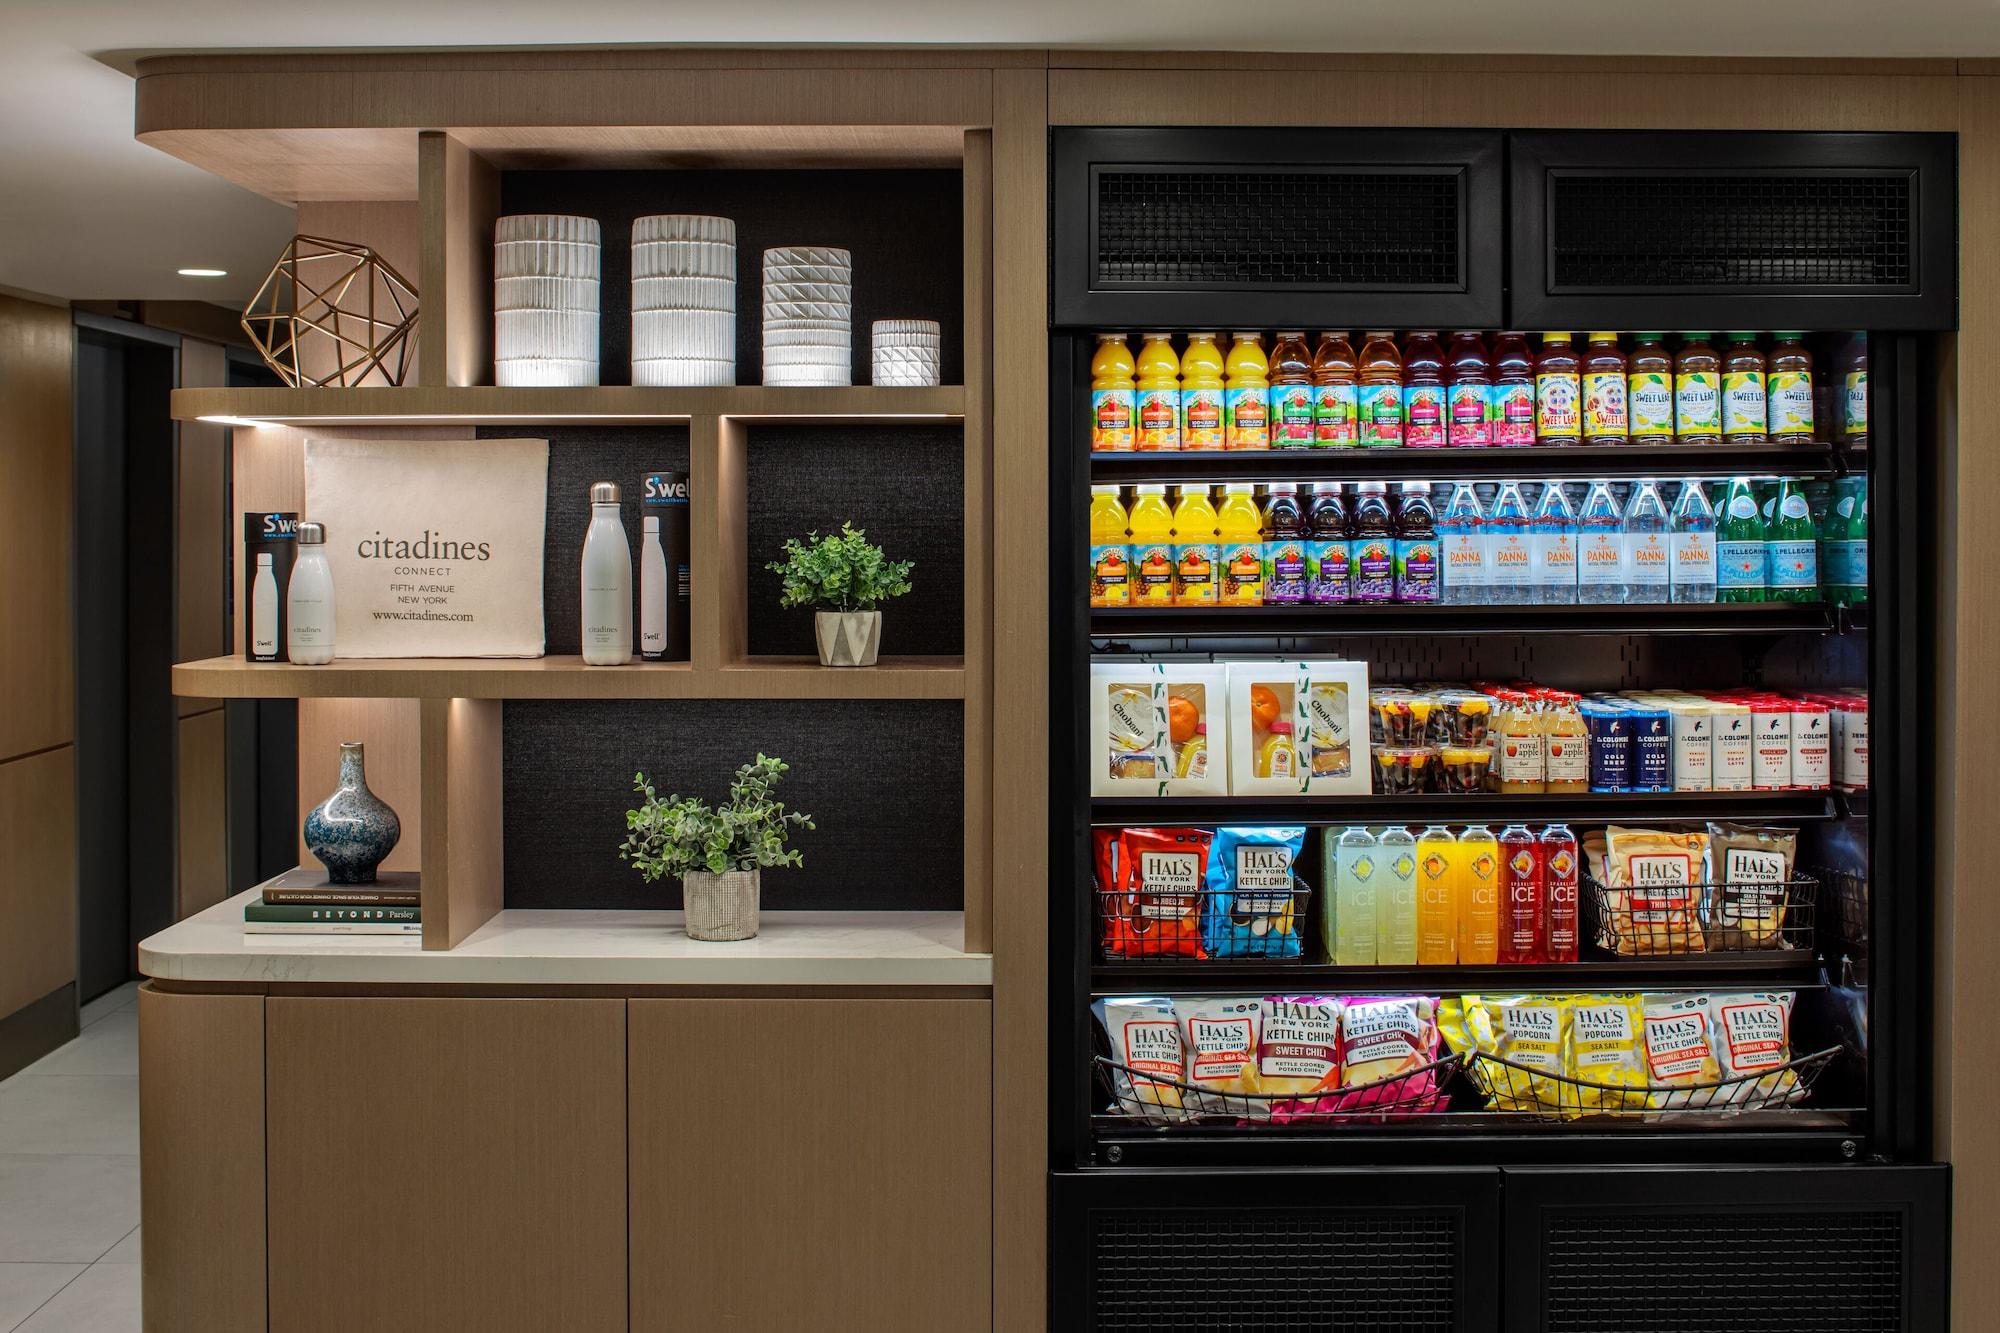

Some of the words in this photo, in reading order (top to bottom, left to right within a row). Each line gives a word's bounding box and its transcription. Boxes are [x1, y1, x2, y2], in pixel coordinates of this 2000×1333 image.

[1636, 393, 1656, 402] SWEET
[1680, 392, 1698, 402] SWEET
[1700, 391, 1714, 401] LEAF
[1732, 391, 1754, 401] SWEET
[1784, 391, 1805, 401] SWEET
[1541, 413, 1561, 424] SWEET
[1563, 412, 1577, 424] LEAF
[1596, 412, 1618, 424] SWEET
[357, 530, 490, 561] citadines
[1450, 552, 1481, 562] PANNA
[1498, 552, 1528, 562] PANNA
[1587, 551, 1618, 561] PANNA
[1636, 551, 1665, 561] PANNA
[1680, 550, 1710, 560] PANNA
[394, 566, 452, 576] CONNECT
[390, 584, 414, 592] FIFTH
[418, 585, 455, 593] AVENUE
[398, 596, 420, 604] NEW
[372, 610, 474, 622] www.citadines.com
[1113, 702, 1144, 737] Chobani
[1312, 700, 1342, 735] Chobani
[1519, 741, 1538, 750] royal
[1564, 741, 1583, 750] royal
[1518, 748, 1539, 758] apple
[1564, 748, 1583, 758] apple
[1244, 852, 1286, 868] HAL'S
[1736, 856, 1778, 874] HAL'S
[1149, 858, 1192, 876] HAL'S
[1639, 862, 1681, 879] HAL'S
[1270, 878, 1289, 886] CHIPS
[1144, 884, 1170, 892] KETTLE
[1351, 890, 1376, 906] ICE
[1392, 888, 1416, 904] ICE
[1422, 888, 1448, 904] ICE
[1472, 888, 1496, 903] ICE
[1511, 886, 1535, 902] ICE
[1550, 886, 1575, 902] ICE
[312, 911, 383, 919] BEYOND
[389, 910, 414, 919] Parsley
[1272, 1002, 1330, 1022] HALS
[1351, 1003, 1409, 1019] HALS
[1579, 1008, 1623, 1024] HAL'S
[1352, 1016, 1375, 1024] NEW
[1509, 1010, 1552, 1025] HAL'S
[1733, 1010, 1778, 1025] HAL'S
[1272, 1019, 1297, 1027] NEW
[1302, 1020, 1328, 1028] YORK
[1346, 1022, 1384, 1037] KETTLE
[1387, 1021, 1416, 1033] CHIPS
[1651, 1020, 1696, 1036] HAL'S
[1135, 1028, 1176, 1044] HAL'S
[1199, 1024, 1243, 1037] HAL'S
[1266, 1030, 1303, 1040] KETTLE
[1513, 1030, 1550, 1040] POPCORN
[1585, 1030, 1622, 1039] POPCORN
[1357, 1034, 1384, 1047] SWEET
[1732, 1033, 1762, 1042] KETTLE
[1196, 1043, 1223, 1051] KETTLE
[1276, 1046, 1303, 1056] SWEET
[1306, 1047, 1327, 1058] CHILI
[1651, 1042, 1680, 1053] KETTLE
[1733, 1045, 1762, 1053] ORIGINAL
[1132, 1051, 1159, 1059] KETTLE
[1161, 1052, 1181, 1062] CHIPS
[1652, 1054, 1681, 1064] ORIGINAL
[1160, 1064, 1172, 1072] SEA
